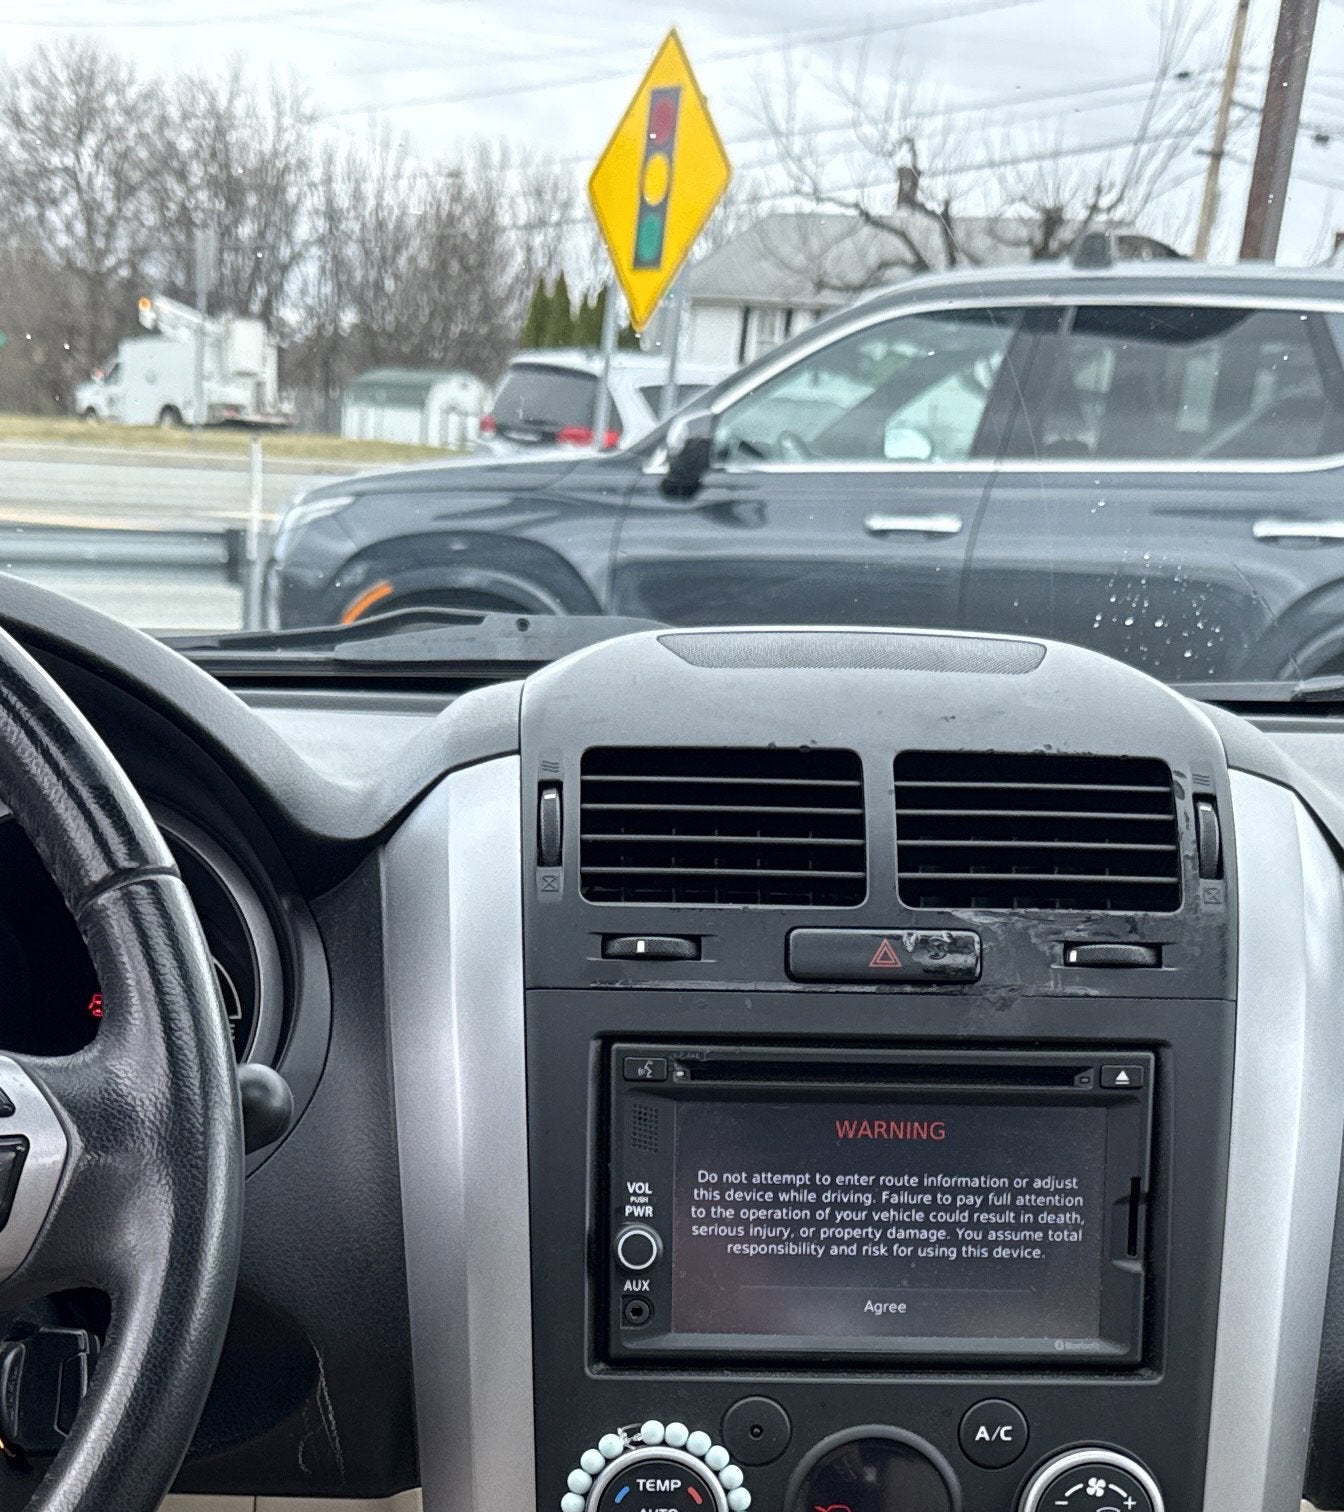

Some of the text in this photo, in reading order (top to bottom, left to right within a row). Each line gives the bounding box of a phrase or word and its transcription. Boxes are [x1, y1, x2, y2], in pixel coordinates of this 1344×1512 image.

[835, 1119, 946, 1141] WARNING
[627, 1181, 653, 1194] VOL
[698, 1170, 1079, 1191] Do not attempt to enter route information or adjust
[629, 1196, 649, 1204] PUSH
[693, 1188, 1084, 1208] this device while driving. Failure to pay full attention
[624, 1205, 654, 1218] PWR
[691, 1206, 1085, 1226] to the operation of your vehicle could result in death,
[691, 1223, 1083, 1242] serious injury, or property damage. You assume total
[727, 1242, 1046, 1260] responsibility and risk for using this device.
[623, 1279, 651, 1292] AUX
[863, 1300, 907, 1316] Agree
[975, 1425, 1013, 1441] A/C
[636, 1478, 682, 1492] TEMP
